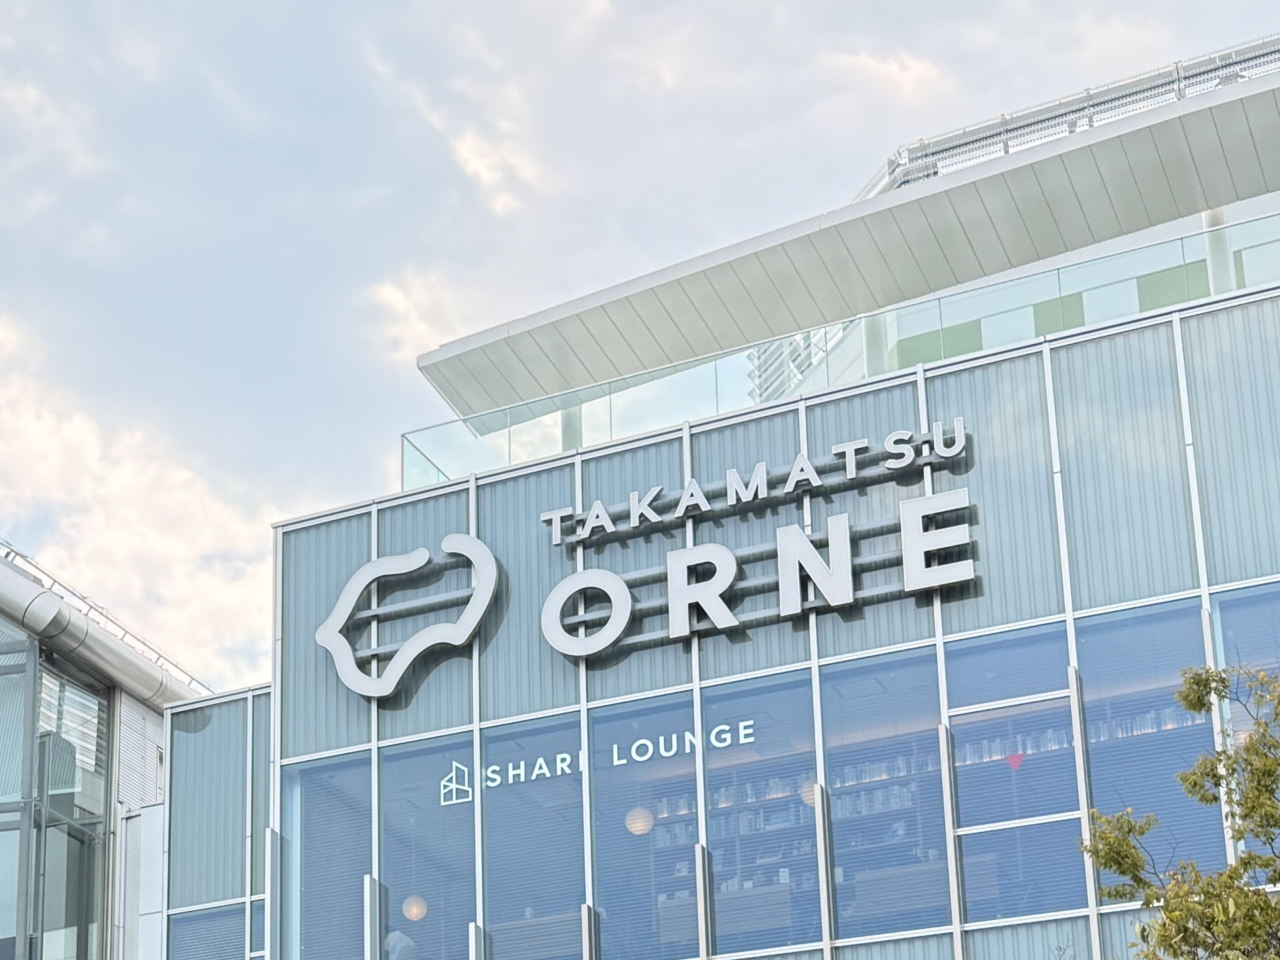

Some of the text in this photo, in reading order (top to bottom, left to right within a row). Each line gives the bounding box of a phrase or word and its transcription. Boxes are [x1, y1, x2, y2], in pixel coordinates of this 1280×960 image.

[540, 417, 967, 545] TAKAMATSU
[541, 488, 975, 656] ORNE
[612, 719, 755, 766] LOUNGE
